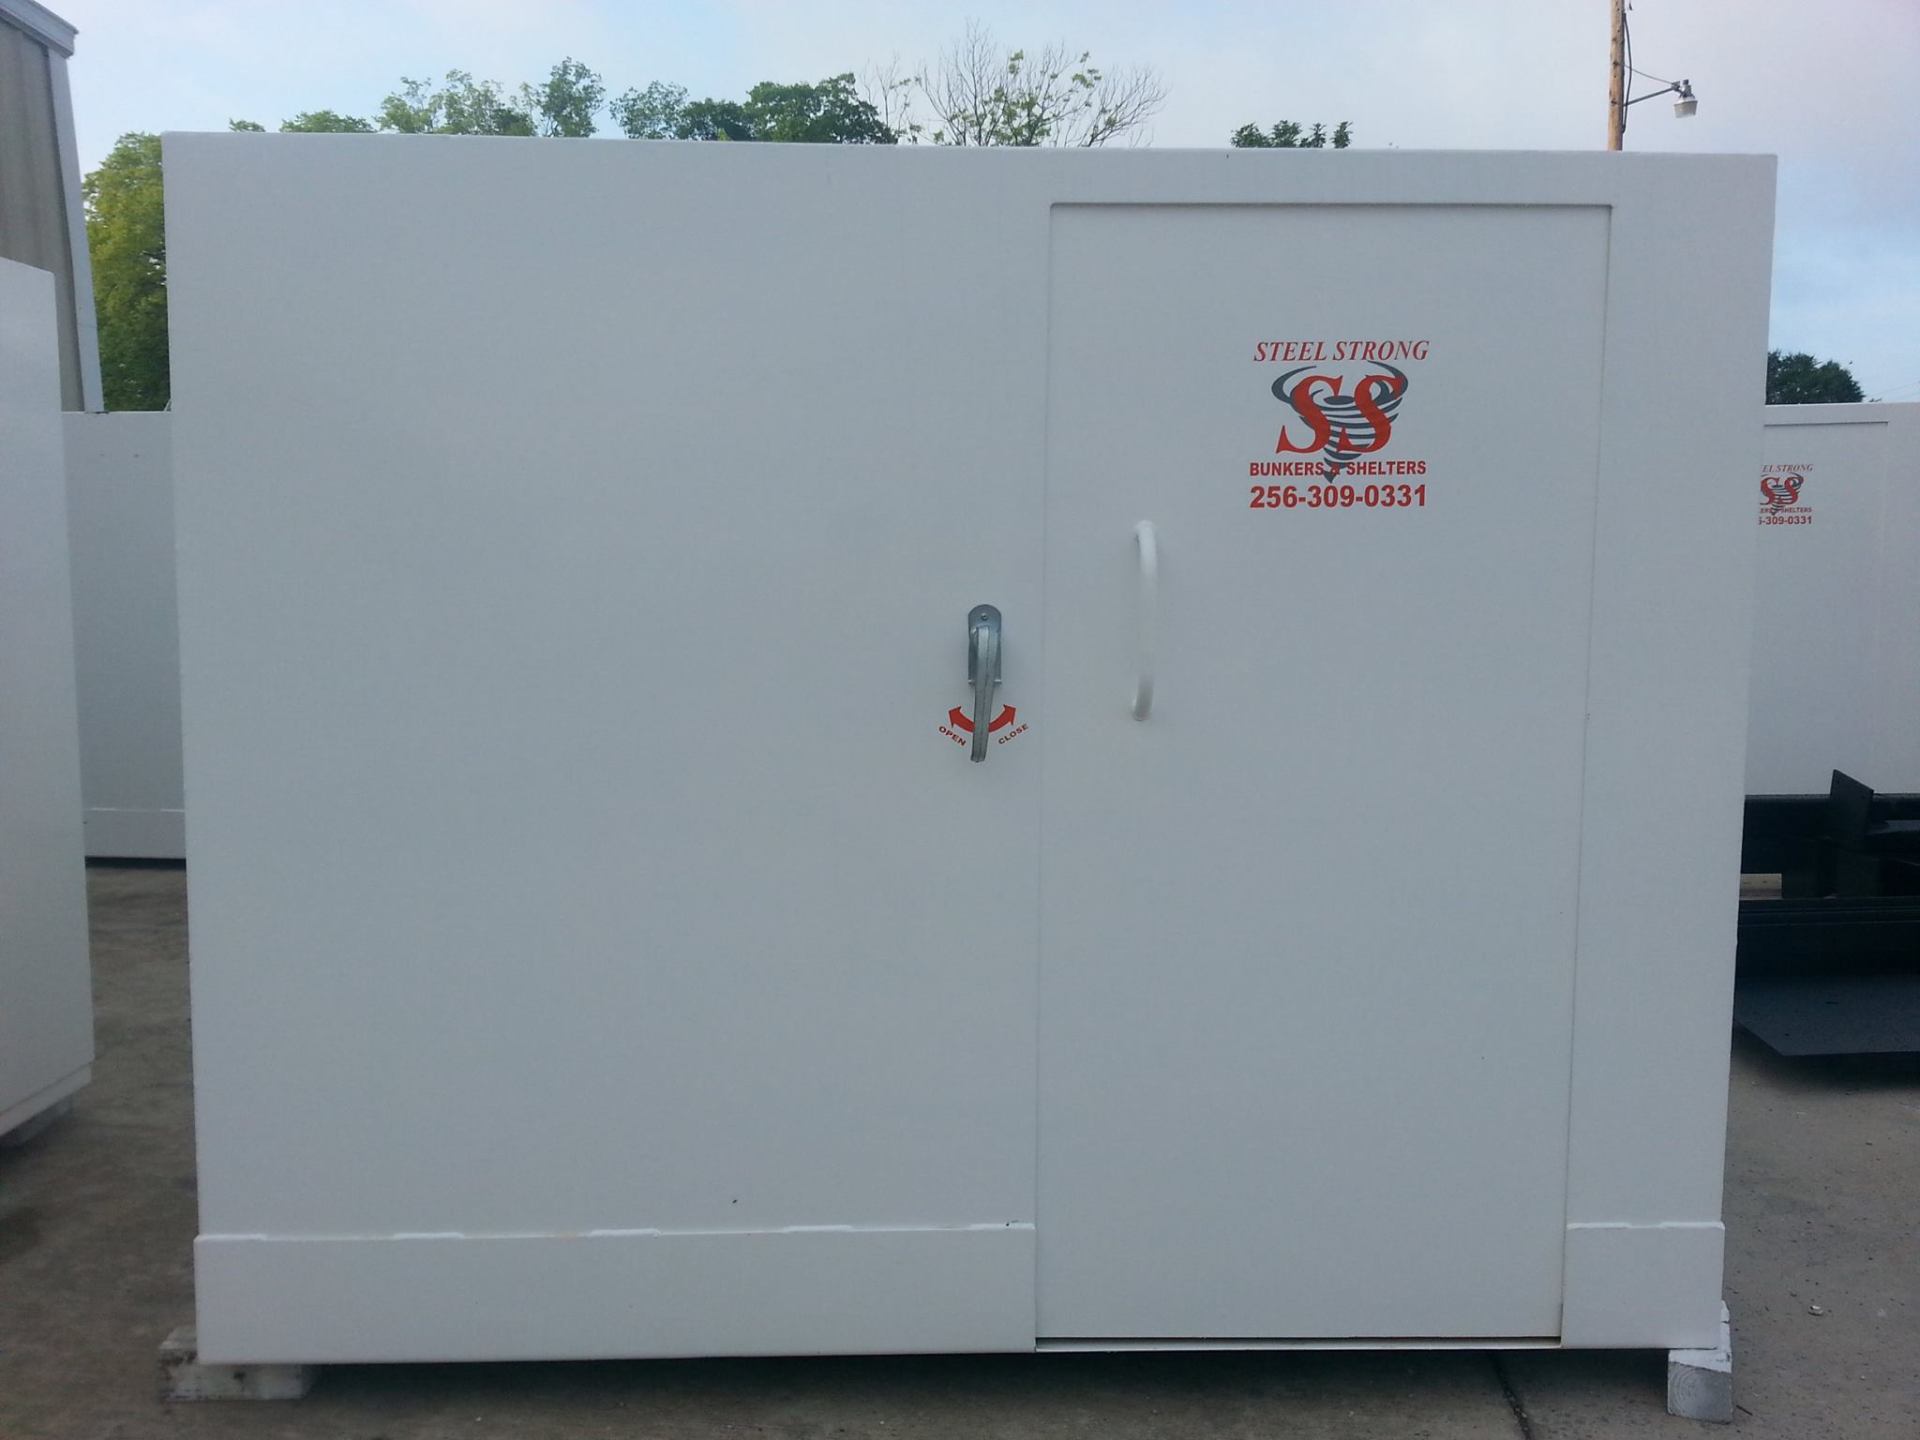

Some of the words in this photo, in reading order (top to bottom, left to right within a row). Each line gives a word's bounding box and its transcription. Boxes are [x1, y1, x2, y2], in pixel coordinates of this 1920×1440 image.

[1254, 341, 1328, 362] STEEL
[1333, 340, 1430, 361] STRONG
[1250, 462, 1324, 476] BUNKERS
[1346, 460, 1427, 475] SHELTERS
[1776, 464, 1813, 472] STRONG
[1250, 484, 1426, 508] 256-309-0331
[938, 726, 967, 746] OPEN
[998, 723, 1029, 745] CLOSE
